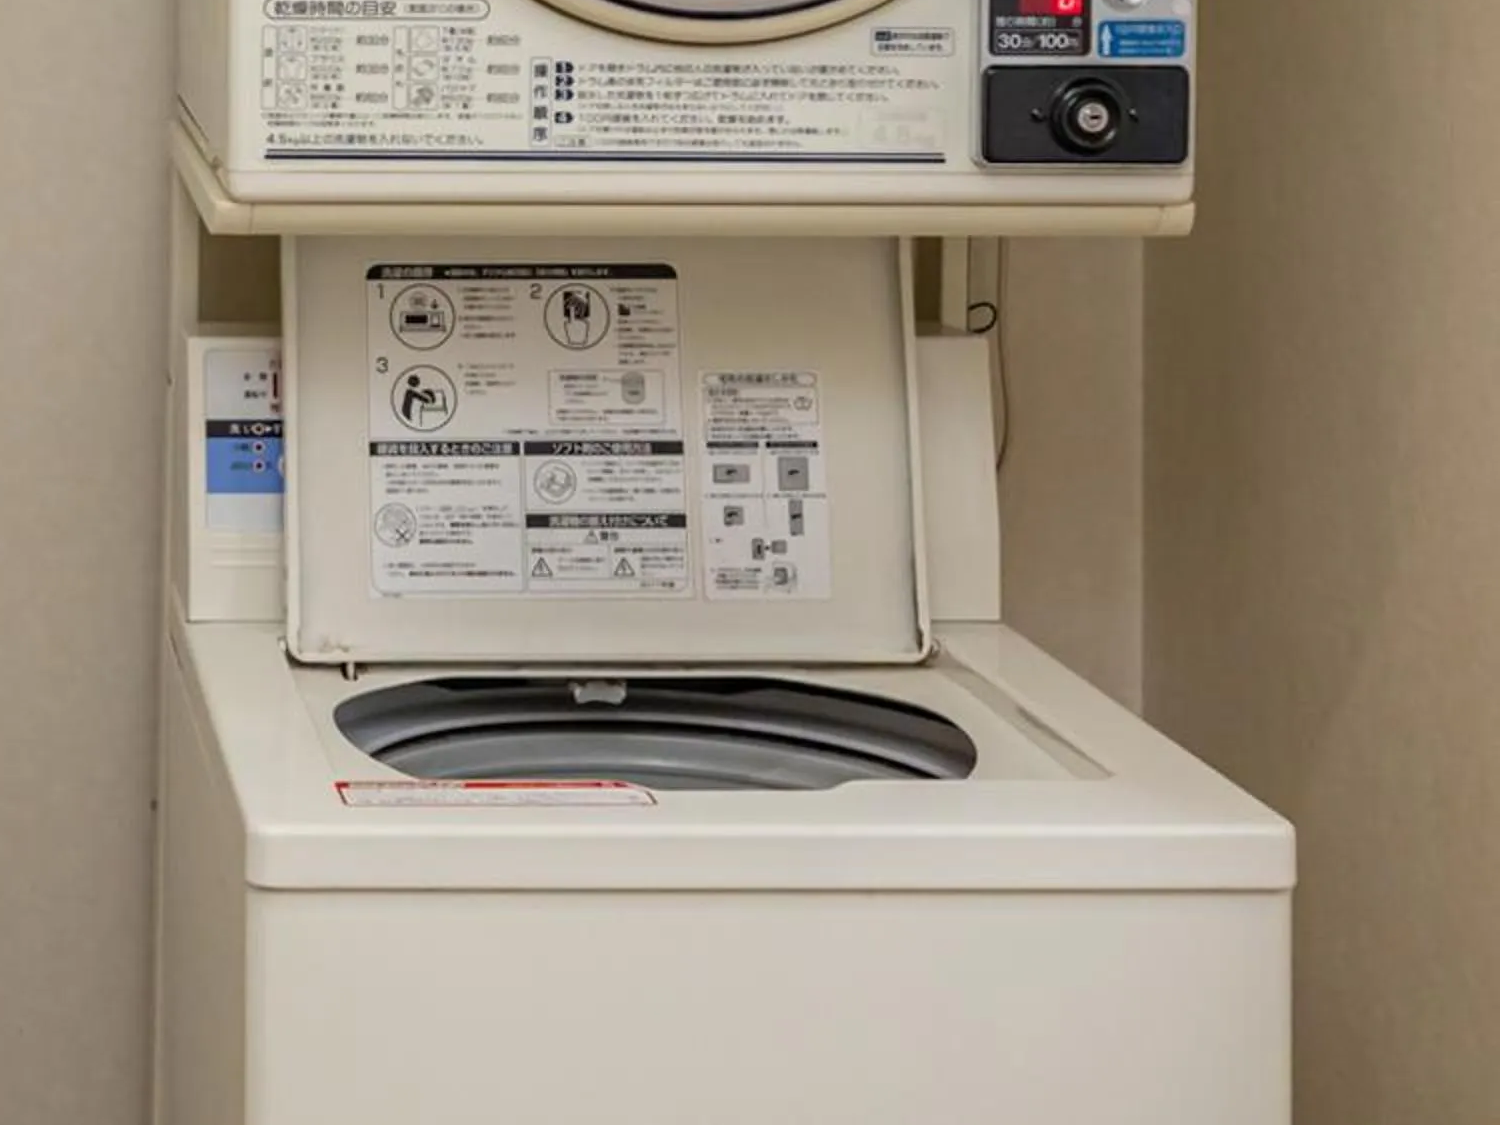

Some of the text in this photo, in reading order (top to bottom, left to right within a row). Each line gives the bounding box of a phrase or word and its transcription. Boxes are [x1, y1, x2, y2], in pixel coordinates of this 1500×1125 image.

[375, 283, 385, 300] 1
[529, 283, 543, 300] 2
[375, 356, 389, 374] 3
